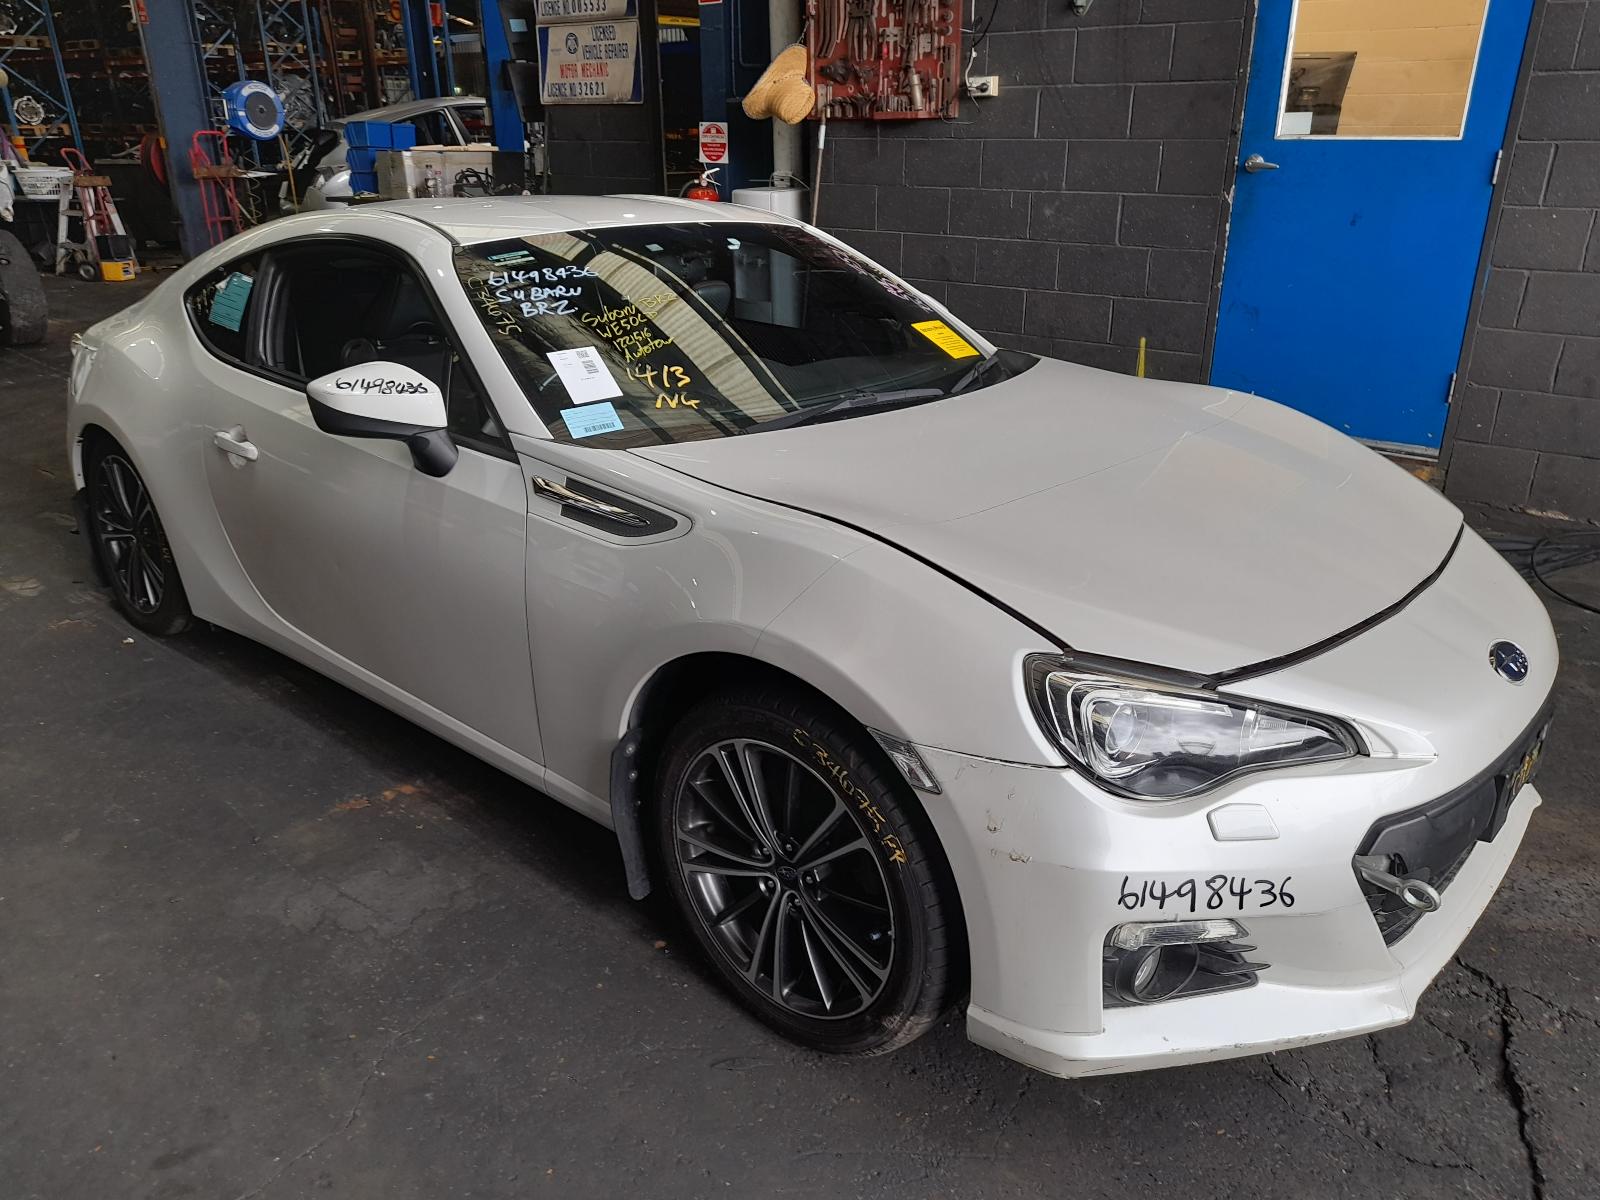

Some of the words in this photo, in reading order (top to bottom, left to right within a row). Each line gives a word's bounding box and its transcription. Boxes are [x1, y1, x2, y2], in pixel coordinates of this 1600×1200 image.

[591, 25, 617, 41] LICENSED
[582, 44, 602, 60] VEHICLE
[605, 43, 629, 59] REPAIRER
[560, 63, 578, 78] MOTOR
[581, 62, 609, 77] MECHANIC
[578, 82, 605, 96] 32621
[487, 265, 599, 286] 61498436
[1117, 874, 1295, 913] 61498436
